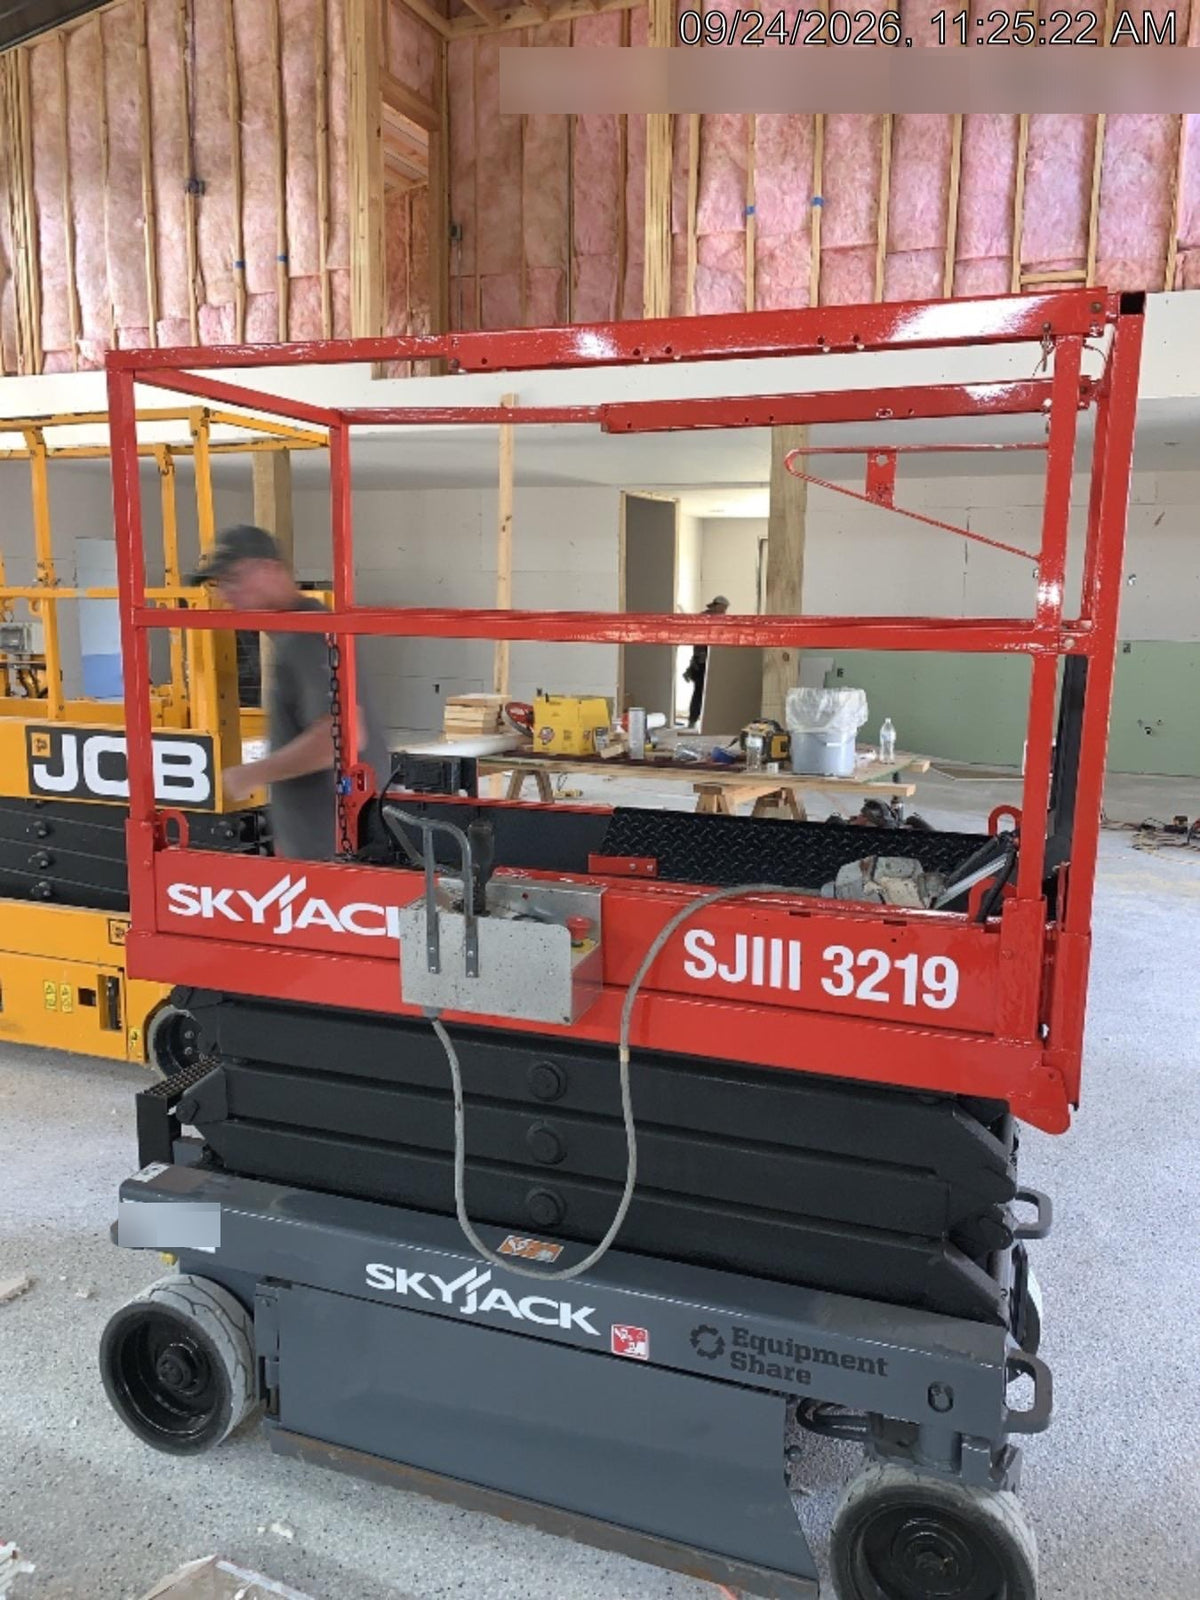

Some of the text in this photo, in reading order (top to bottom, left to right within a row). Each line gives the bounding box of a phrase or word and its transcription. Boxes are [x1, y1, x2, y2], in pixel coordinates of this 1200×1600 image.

[33, 733, 211, 802] JCB
[683, 929, 960, 1010] SJIII 3219
[365, 1262, 602, 1336] SKYJACK
[730, 1350, 812, 1386] Share
[731, 1326, 889, 1377] Equipment
